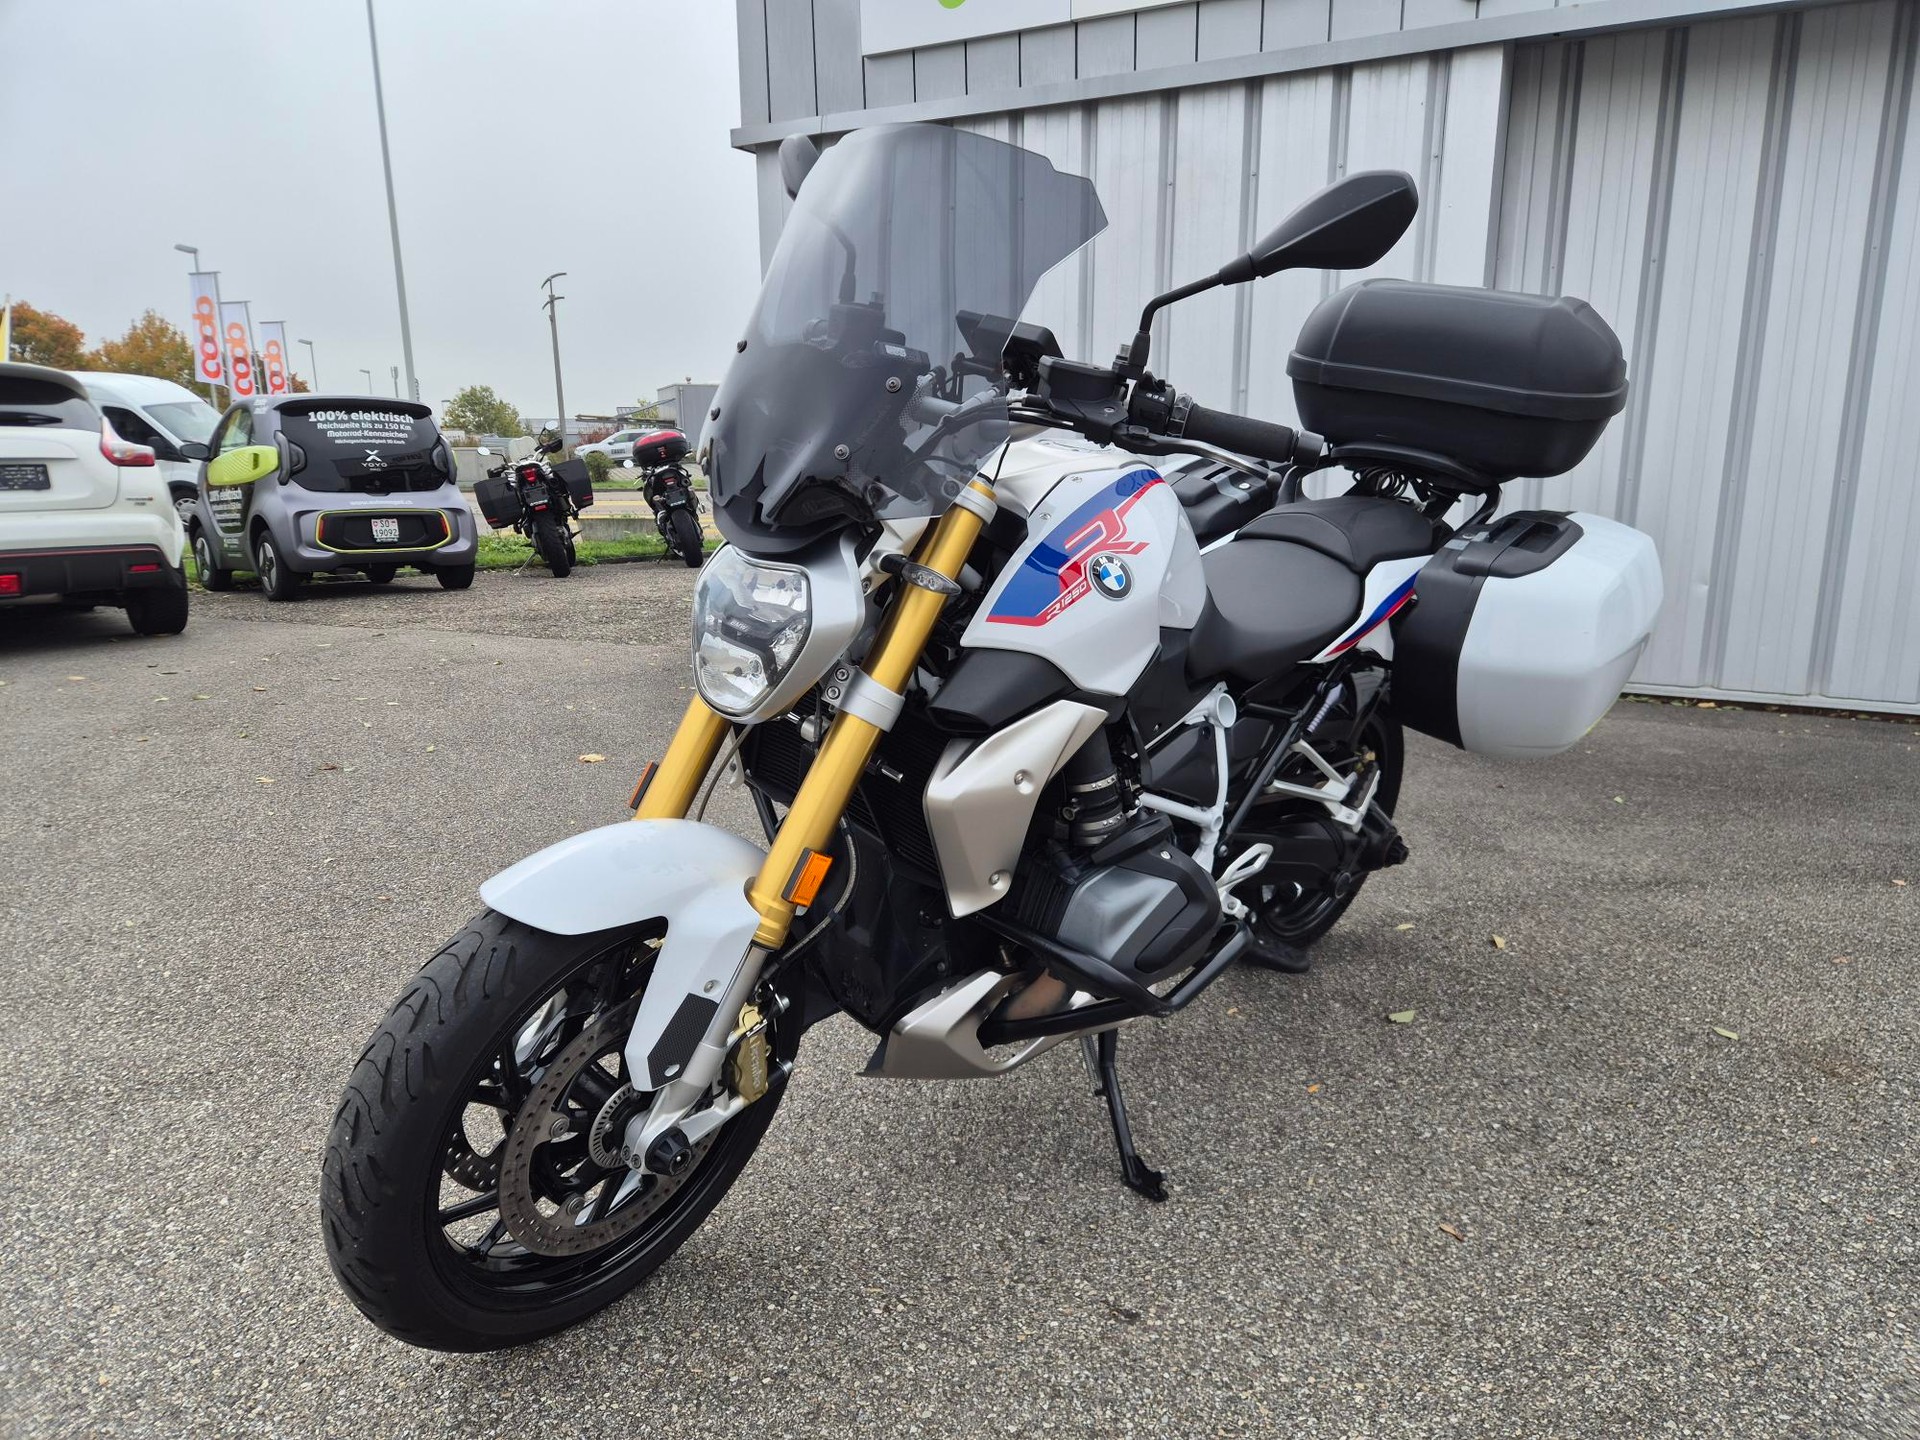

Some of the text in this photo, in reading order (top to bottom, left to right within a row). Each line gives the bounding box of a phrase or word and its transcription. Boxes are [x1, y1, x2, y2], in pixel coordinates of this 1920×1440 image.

[192, 295, 222, 379] coop
[224, 322, 254, 396] coop
[263, 339, 285, 394] oop
[308, 410, 413, 424] 100% elektrisch
[399, 423, 412, 431] Km
[326, 430, 408, 438] Motorrad-Kennzeichen
[380, 520, 390, 528] SO
[374, 529, 398, 537] 19092
